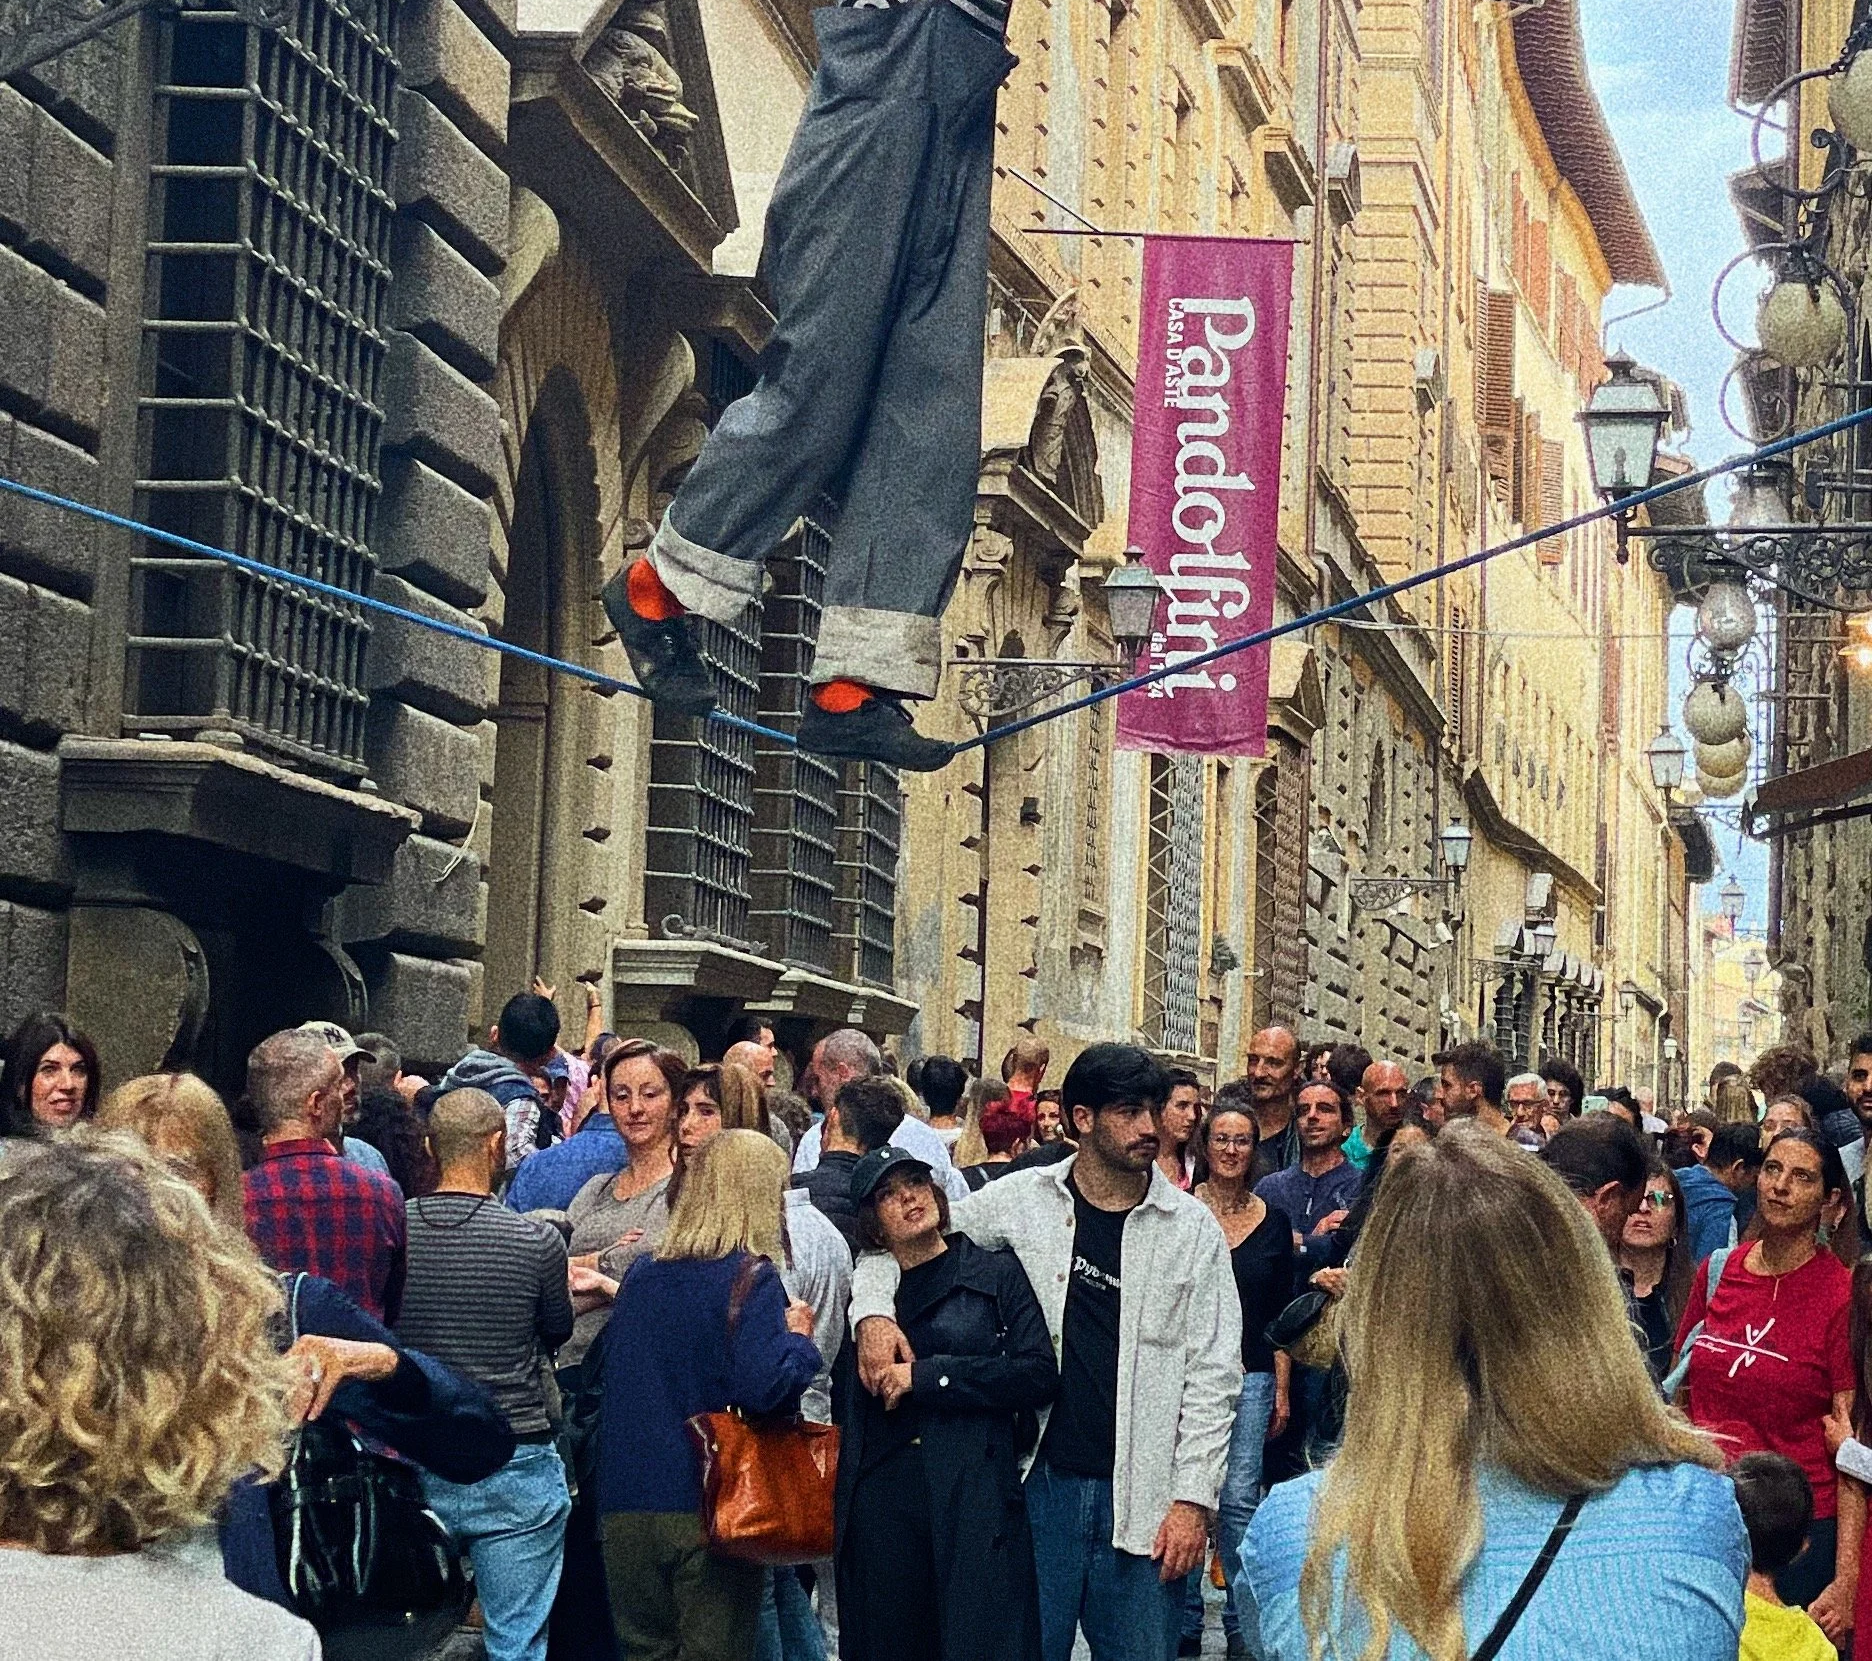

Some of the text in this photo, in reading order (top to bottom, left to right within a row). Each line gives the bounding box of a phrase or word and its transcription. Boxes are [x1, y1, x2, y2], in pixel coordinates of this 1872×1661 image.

[1163, 298, 1185, 408] CASA D'ASTE
[1154, 295, 1256, 699] Pandolfini
[1147, 632, 1167, 699] dal 124
